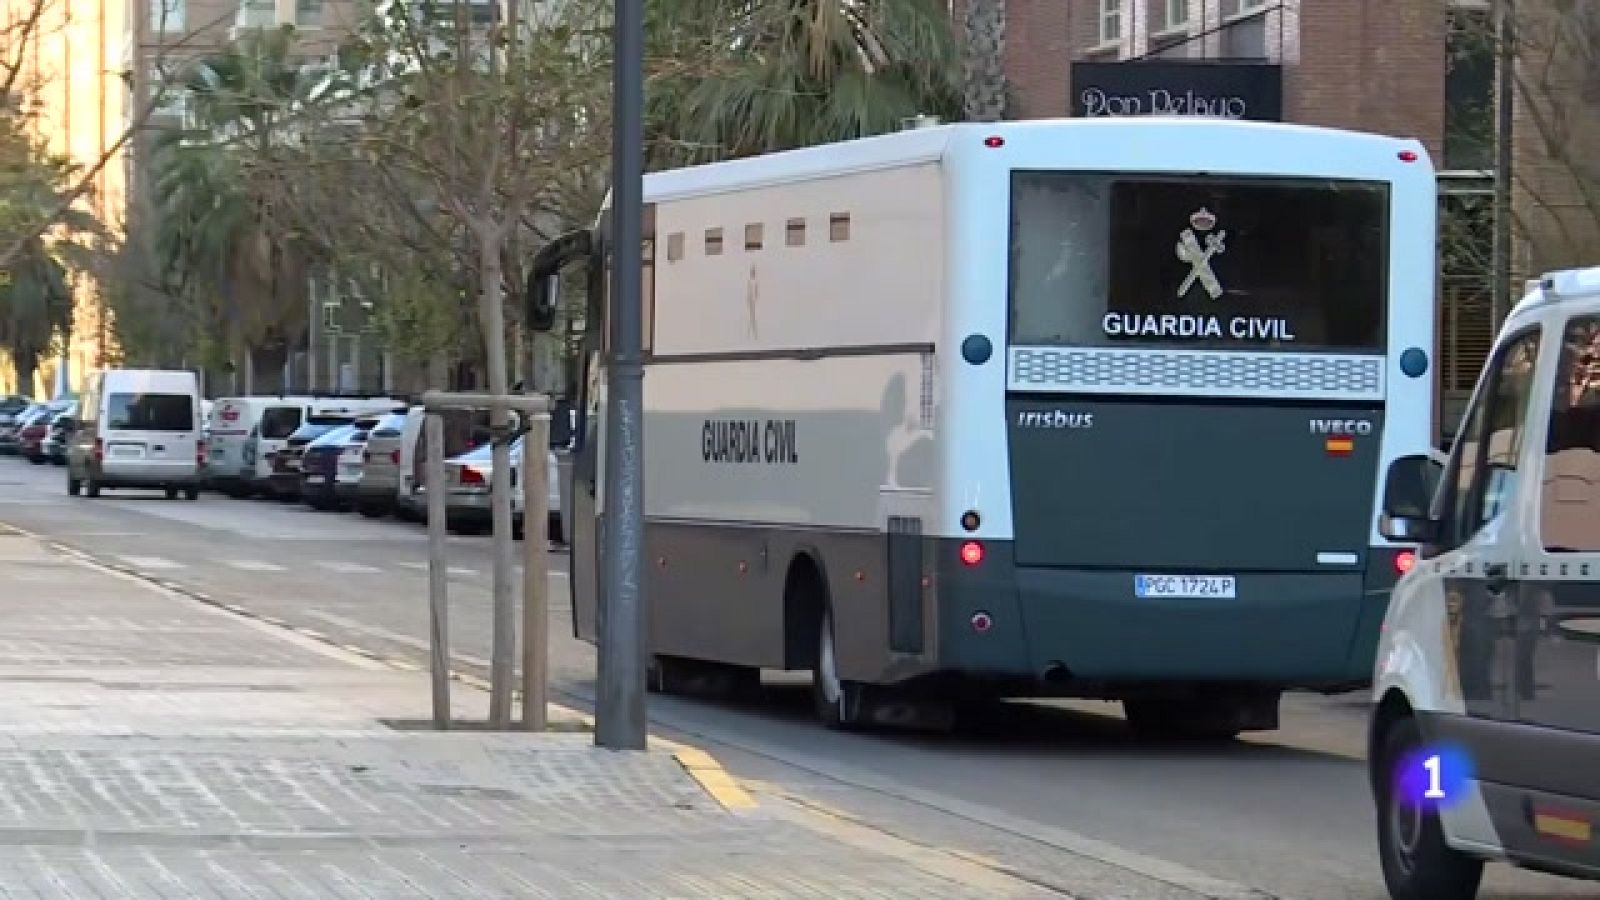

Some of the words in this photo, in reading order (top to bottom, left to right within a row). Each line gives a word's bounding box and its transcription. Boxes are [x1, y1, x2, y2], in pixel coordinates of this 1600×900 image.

[1082, 87, 1141, 116] Don
[1103, 312, 1223, 338] GUARDIA
[1229, 317, 1296, 340] CIVIL
[1308, 418, 1372, 435] IVECO
[701, 419, 761, 464] GUARDIA
[764, 419, 798, 464] CIVIL
[1146, 576, 1176, 594] PGC
